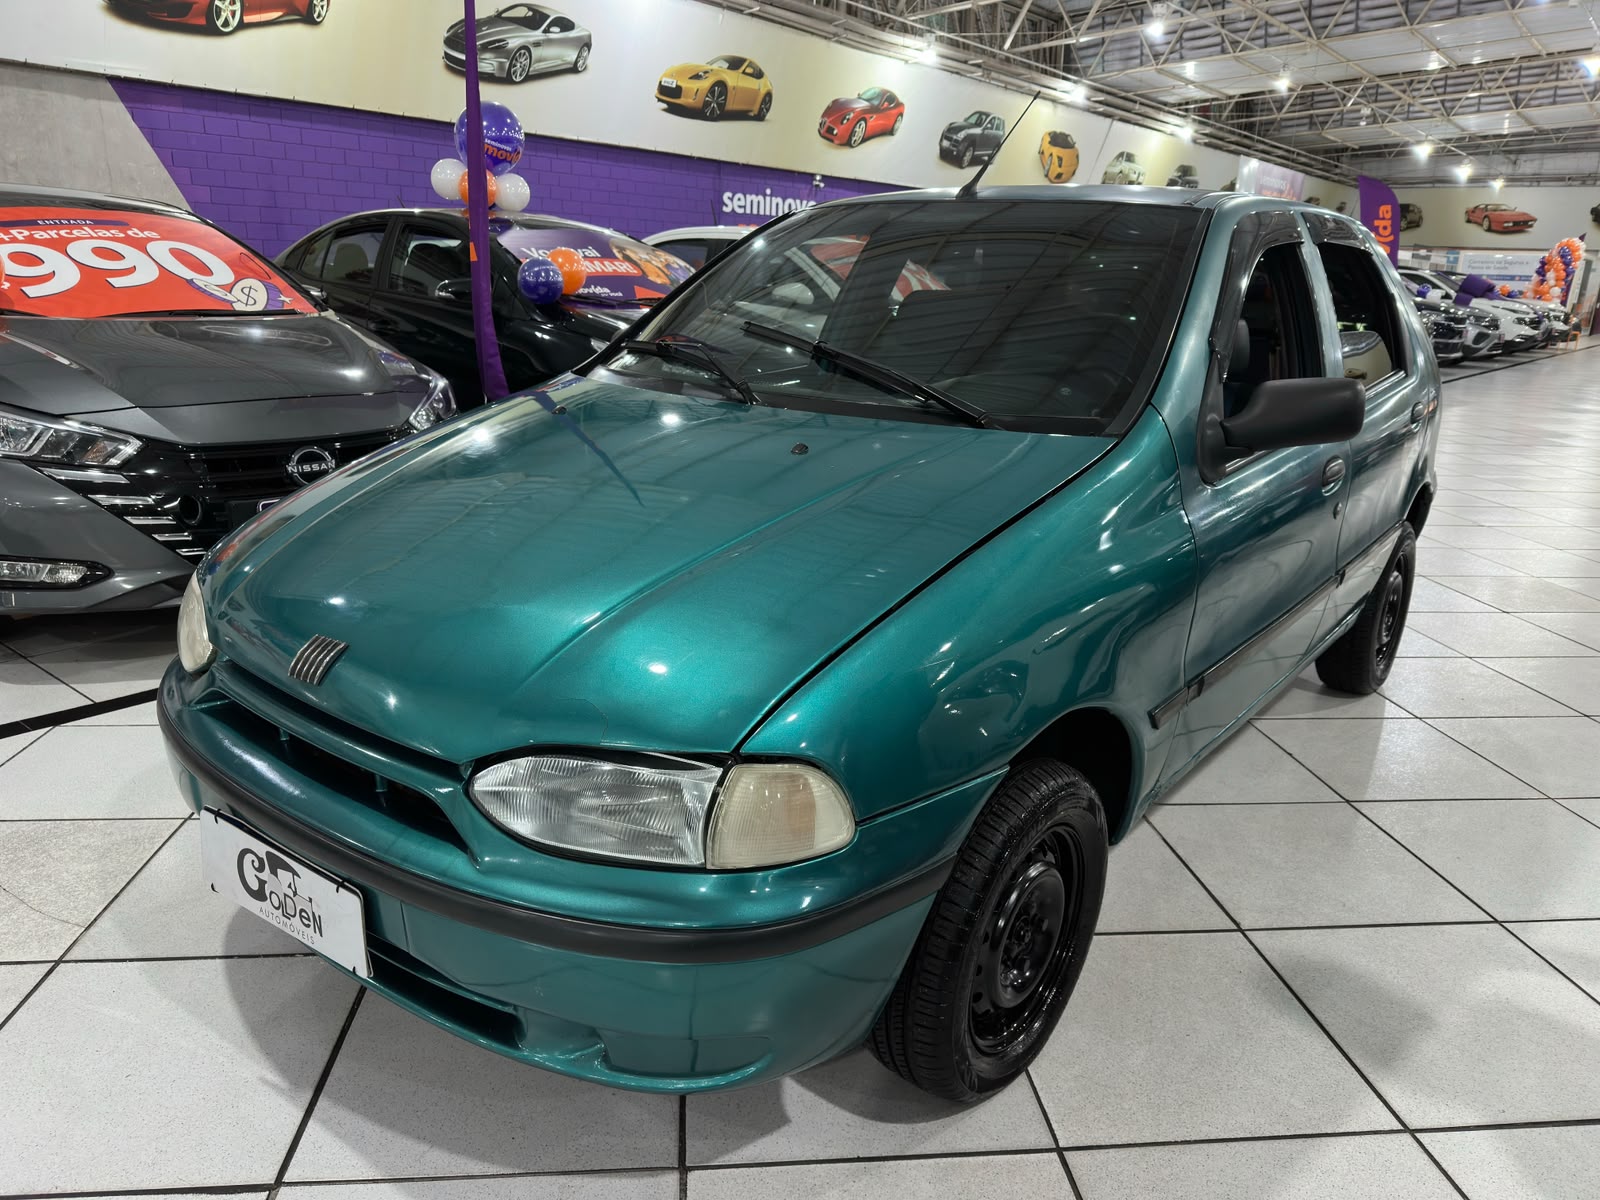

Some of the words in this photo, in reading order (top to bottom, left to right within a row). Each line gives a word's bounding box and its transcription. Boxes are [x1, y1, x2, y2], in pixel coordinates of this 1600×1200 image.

[126, 227, 162, 240] de
[584, 260, 639, 274] MAR!
[286, 459, 336, 474] NISSAN
[259, 906, 316, 945] AUTOMÓVEIS
